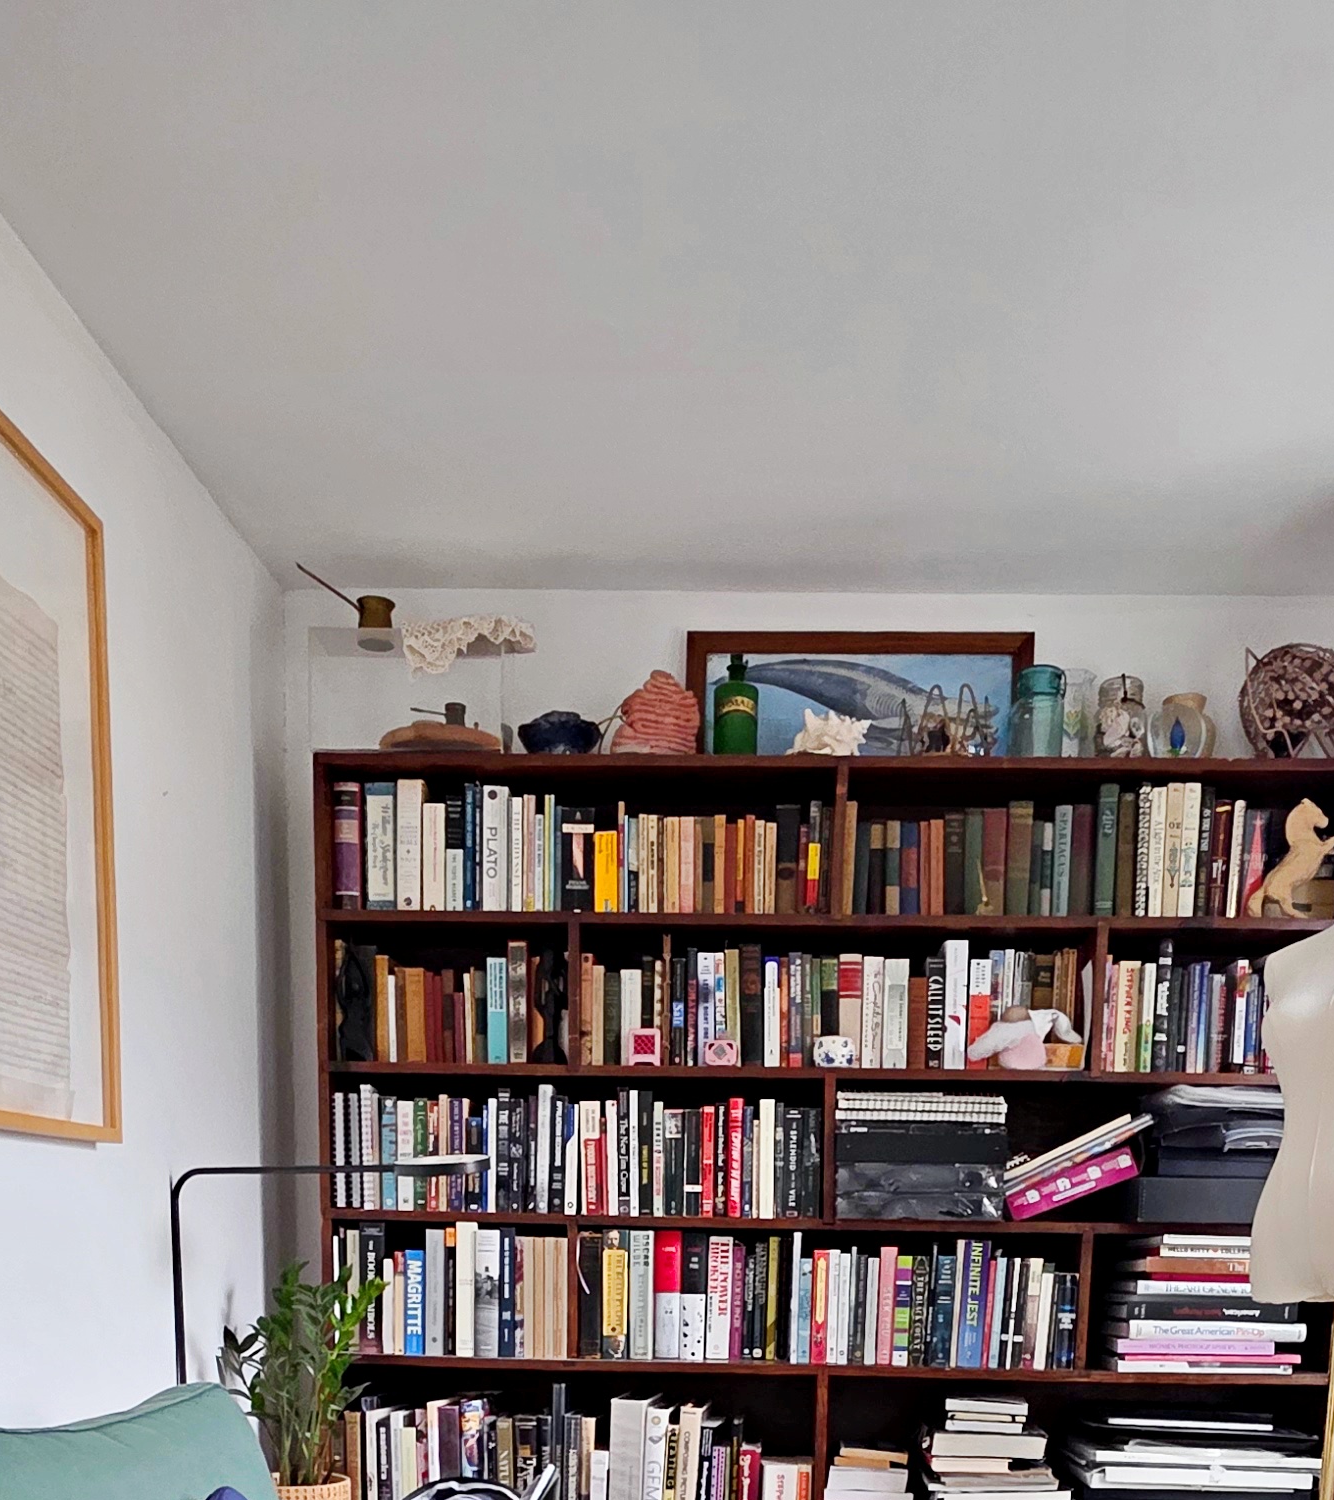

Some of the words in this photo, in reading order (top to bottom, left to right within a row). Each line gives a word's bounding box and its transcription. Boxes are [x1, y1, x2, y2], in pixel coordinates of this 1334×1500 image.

[486, 826, 499, 880] PLATO
[1056, 812, 1069, 877] SPARTACUS
[928, 975, 944, 1001] CALL
[1124, 968, 1135, 1007] STEPHEN
[673, 1002, 684, 1026] Salt
[687, 979, 697, 1049] TOMATOLAND
[927, 1004, 943, 1018] IT
[1122, 1009, 1133, 1035] KING
[926, 1017, 942, 1052] SLEEP
[453, 1100, 461, 1120] JOHN
[452, 1122, 461, 1150] IRVING
[620, 1119, 629, 1135] The
[619, 1136, 628, 1154] New
[788, 1130, 799, 1171] SPLENDID
[619, 1155, 628, 1170] Jim
[619, 1170, 628, 1193] Crow
[787, 1189, 797, 1207] VILE
[633, 1234, 641, 1268] WILDE
[720, 1241, 730, 1266] THE
[709, 1241, 720, 1294] BROKER
[967, 1243, 984, 1296] INFINITE
[407, 1260, 423, 1335] MAGRITTE
[718, 1271, 729, 1317] POWER
[916, 1276, 925, 1293] THE
[914, 1295, 924, 1320] BLACK
[966, 1297, 979, 1327] JEST
[913, 1322, 922, 1350] COUNT
[1153, 1325, 1169, 1335] The
[1169, 1325, 1195, 1336] Great
[1195, 1326, 1235, 1336] American
[1235, 1327, 1266, 1338] Pin-Up
[681, 1431, 691, 1475] COMPOSING
